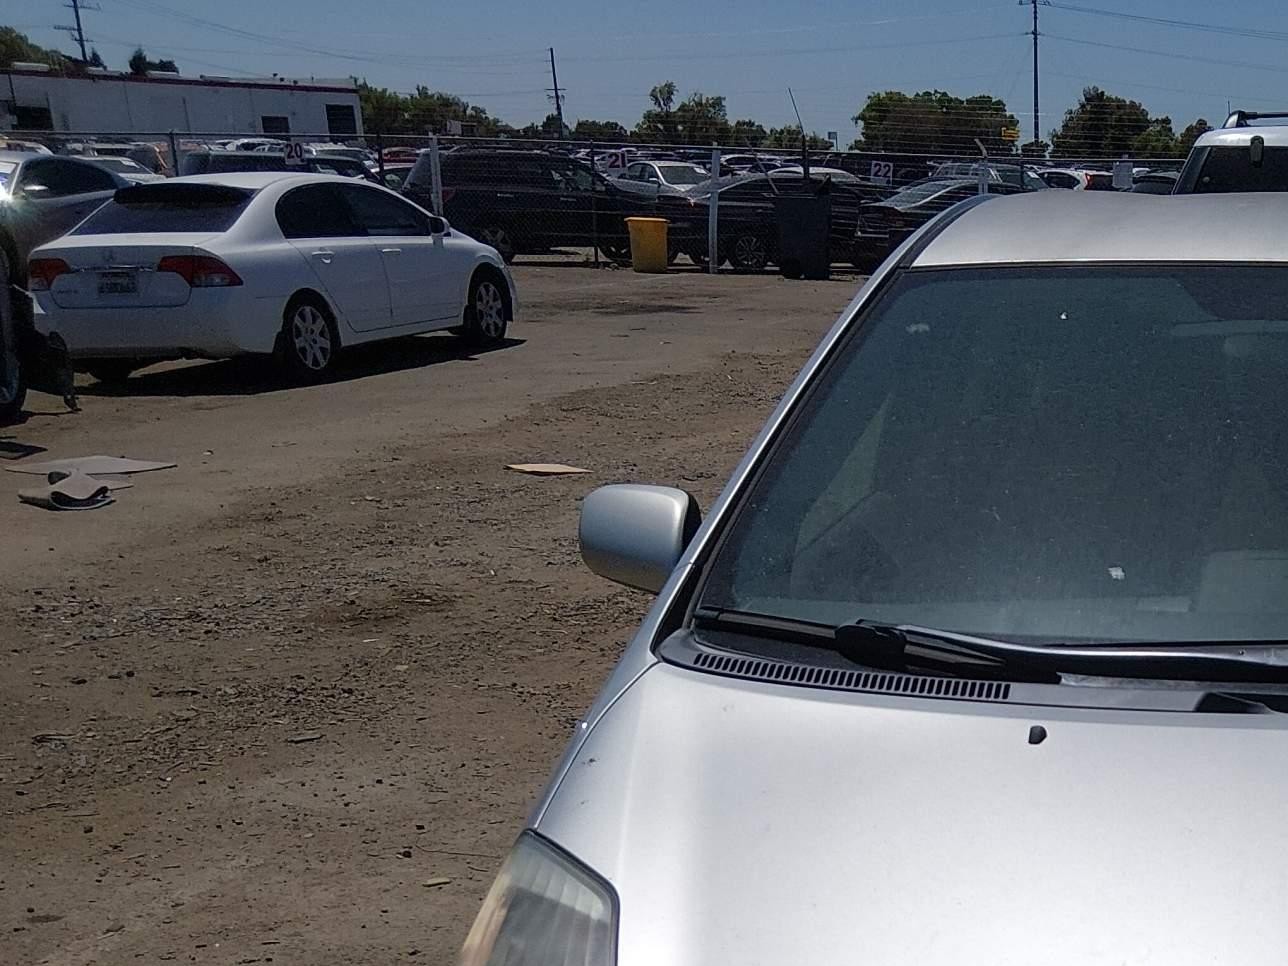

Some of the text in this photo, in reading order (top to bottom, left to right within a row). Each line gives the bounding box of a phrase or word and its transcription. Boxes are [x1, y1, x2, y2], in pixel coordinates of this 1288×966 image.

[285, 142, 303, 159] 20
[608, 152, 627, 169] 21
[873, 162, 891, 178] 22
